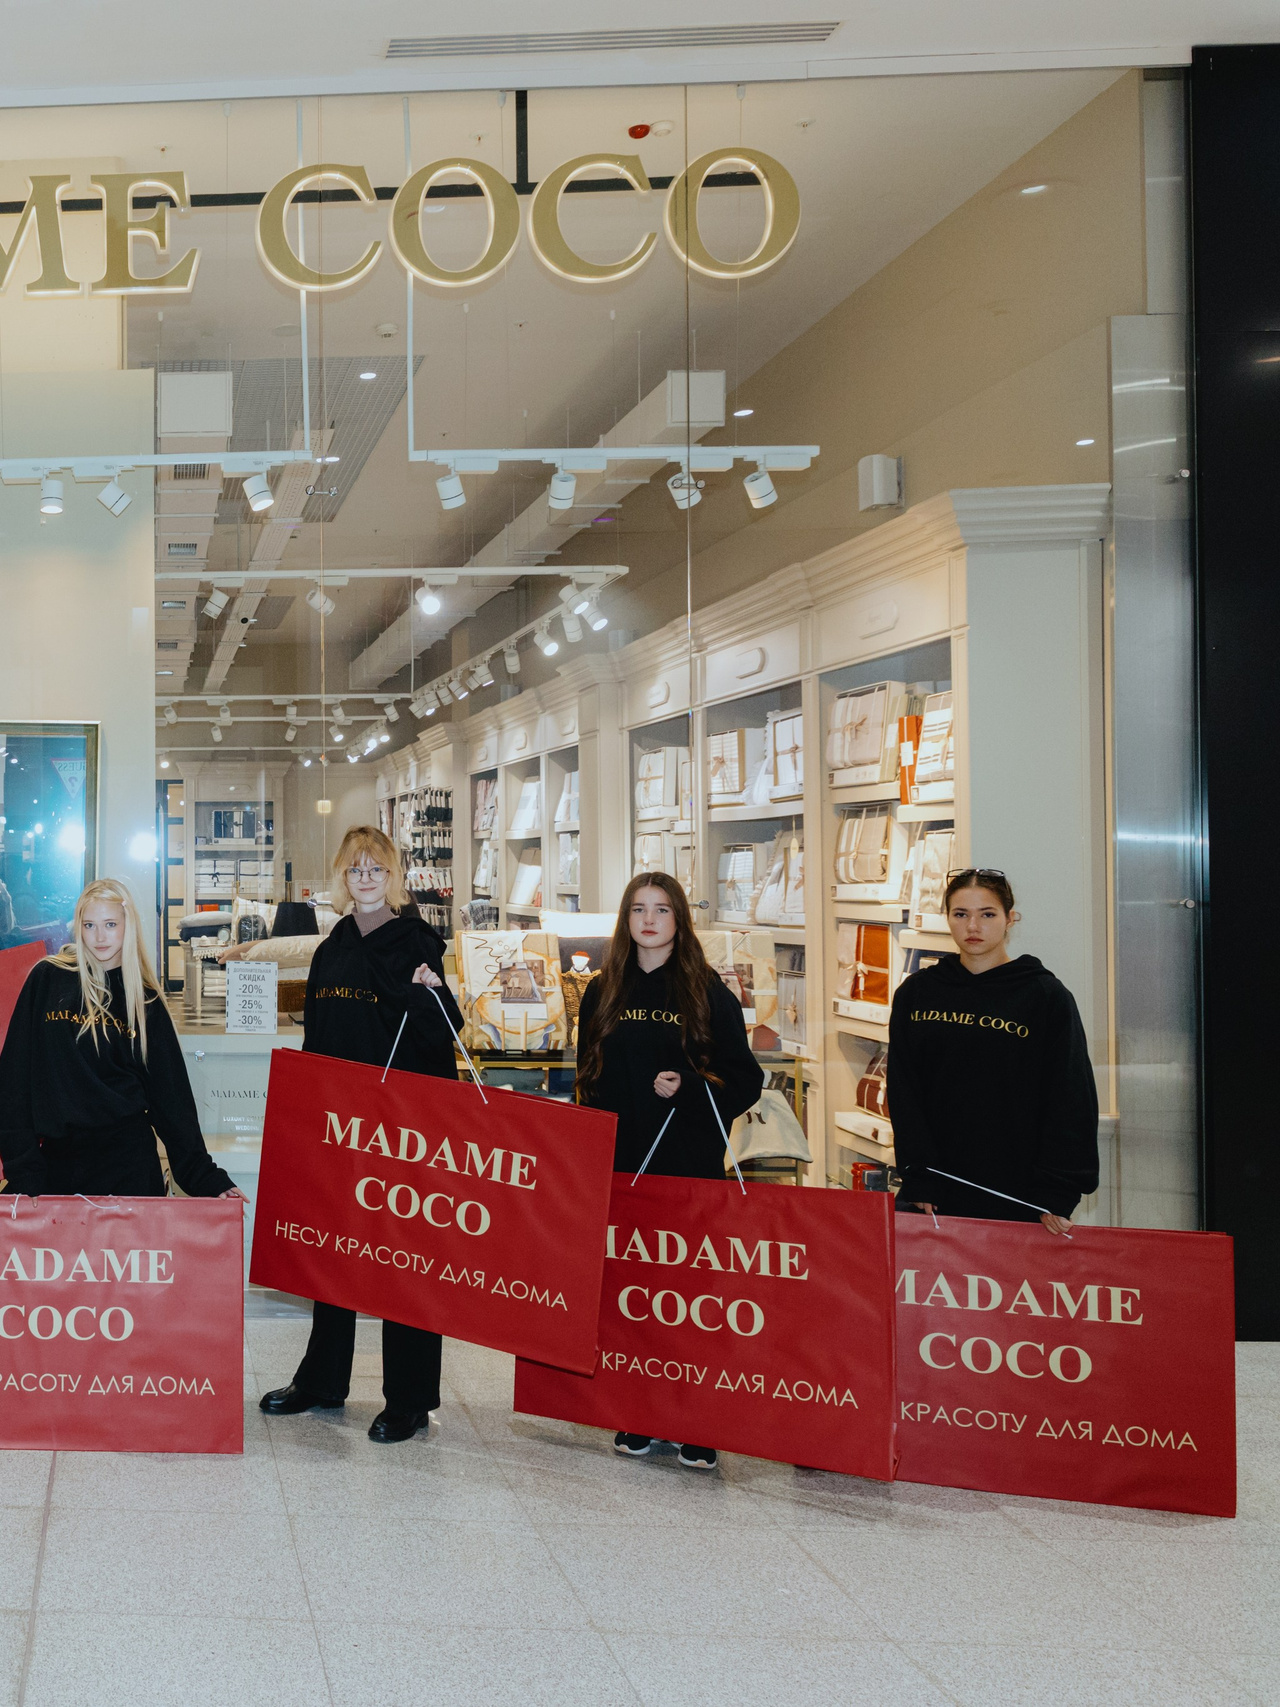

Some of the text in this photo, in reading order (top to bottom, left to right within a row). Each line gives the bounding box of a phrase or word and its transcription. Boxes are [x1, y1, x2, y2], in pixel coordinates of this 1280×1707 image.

[255, 147, 801, 292] COCO
[238, 974, 266, 982] СКИДКА
[239, 984, 263, 994] -20%
[238, 1015, 262, 1025] -30%
[239, 1000, 263, 1009] -25%
[979, 1015, 1029, 1038] COCO
[210, 1090, 260, 1099] MADAME
[321, 1111, 537, 1190] MADAME
[354, 1177, 491, 1236] COCO
[275, 1220, 568, 1312] НЕСУ КРАСОТУ ДЛЯ ДОМА
[618, 1286, 765, 1337] COCO
[602, 1351, 859, 1410] КРАСОТУ ДЛЯ ДОМА
[919, 1332, 1093, 1383] COCO
[87, 1375, 134, 1396] ДЛЯ
[140, 1376, 216, 1396] ДОМА
[901, 1402, 1198, 1452] КРАСОТУ ДЛЯ ДОМА
